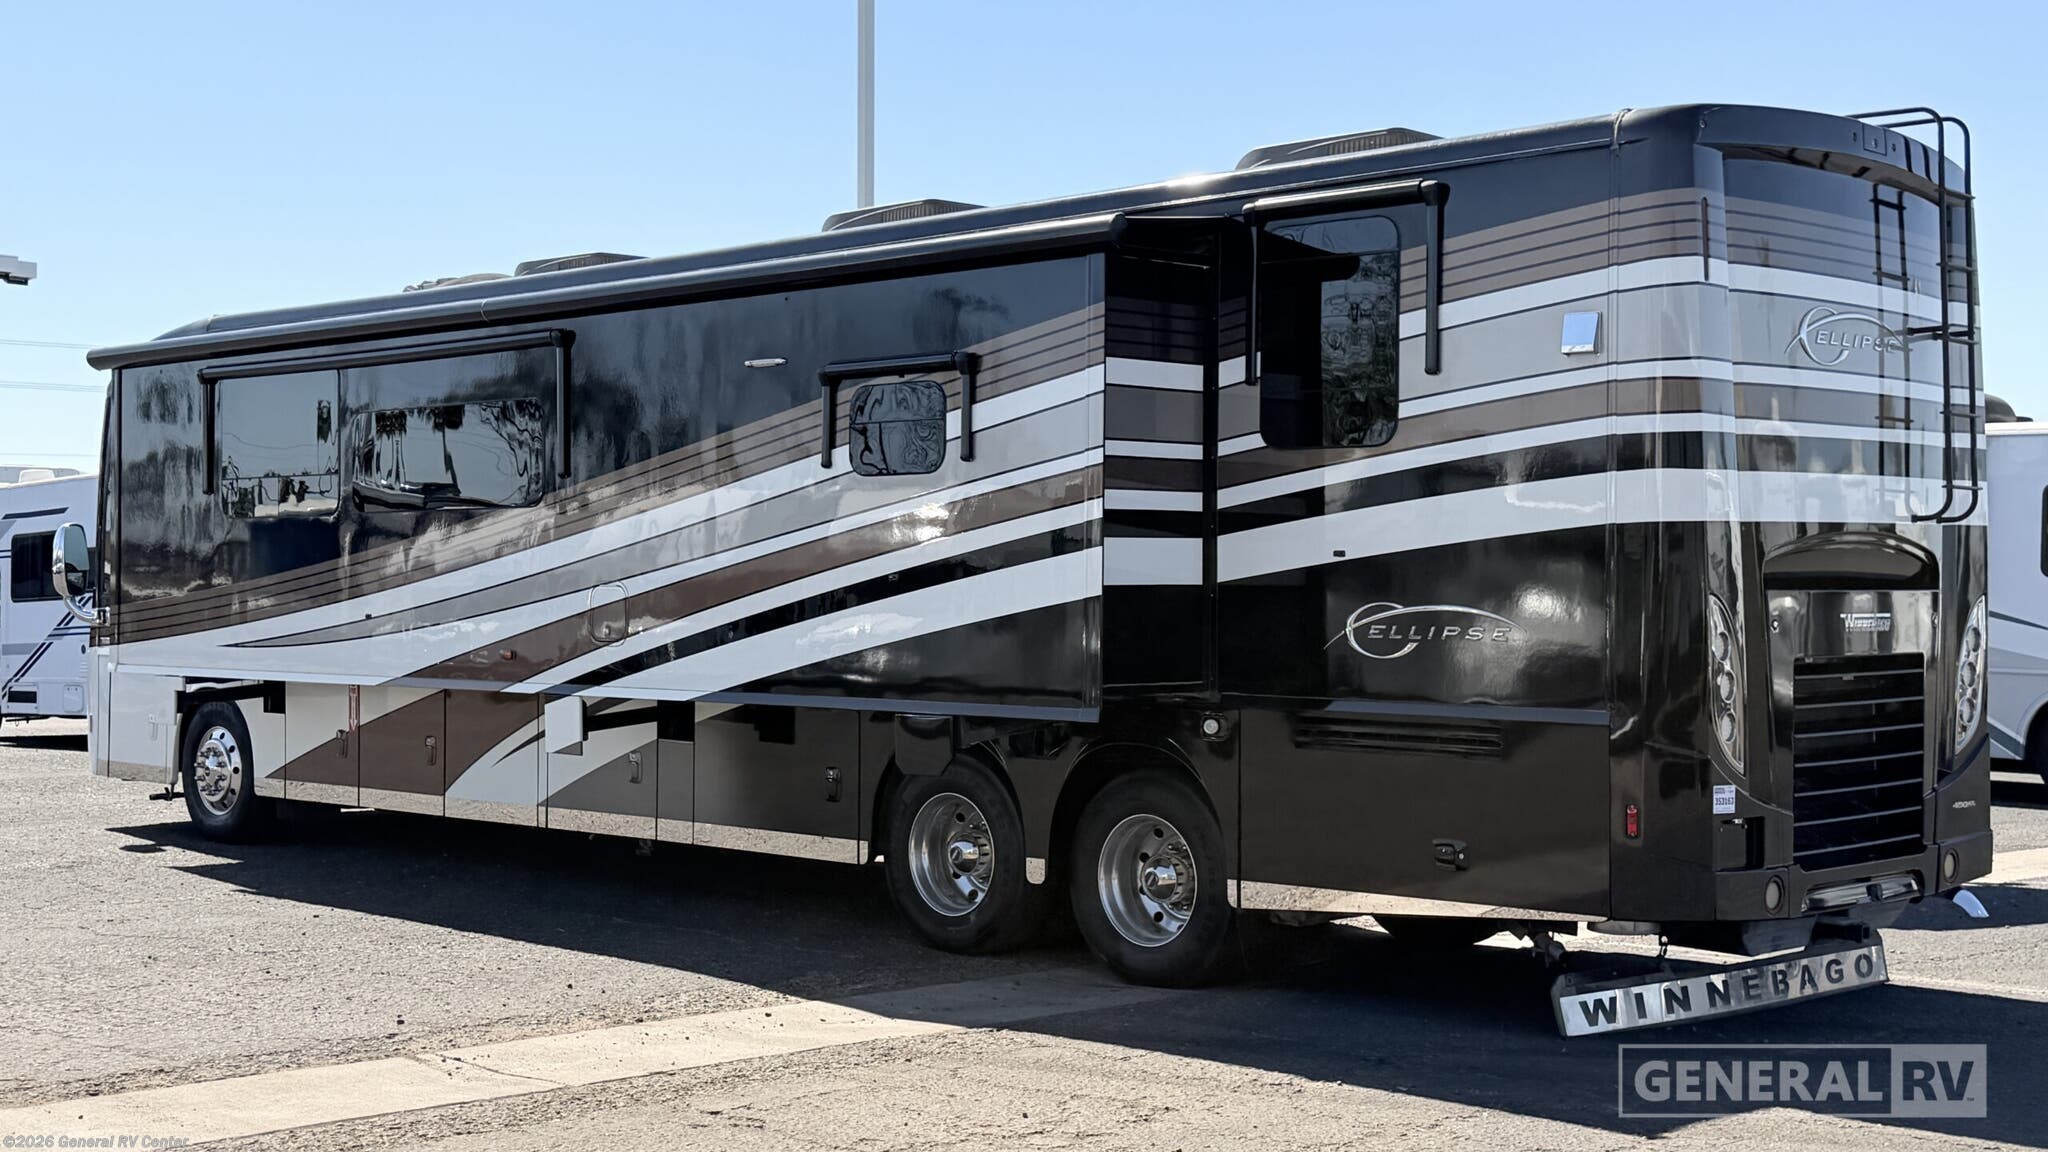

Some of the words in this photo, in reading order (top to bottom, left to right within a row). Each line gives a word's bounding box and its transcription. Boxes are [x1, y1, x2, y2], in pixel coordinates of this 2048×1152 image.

[1816, 330, 1898, 354] ELLIPSE
[1368, 625, 1513, 643] ELLIPSE
[1578, 953, 1874, 1028] WINNEBAGO
